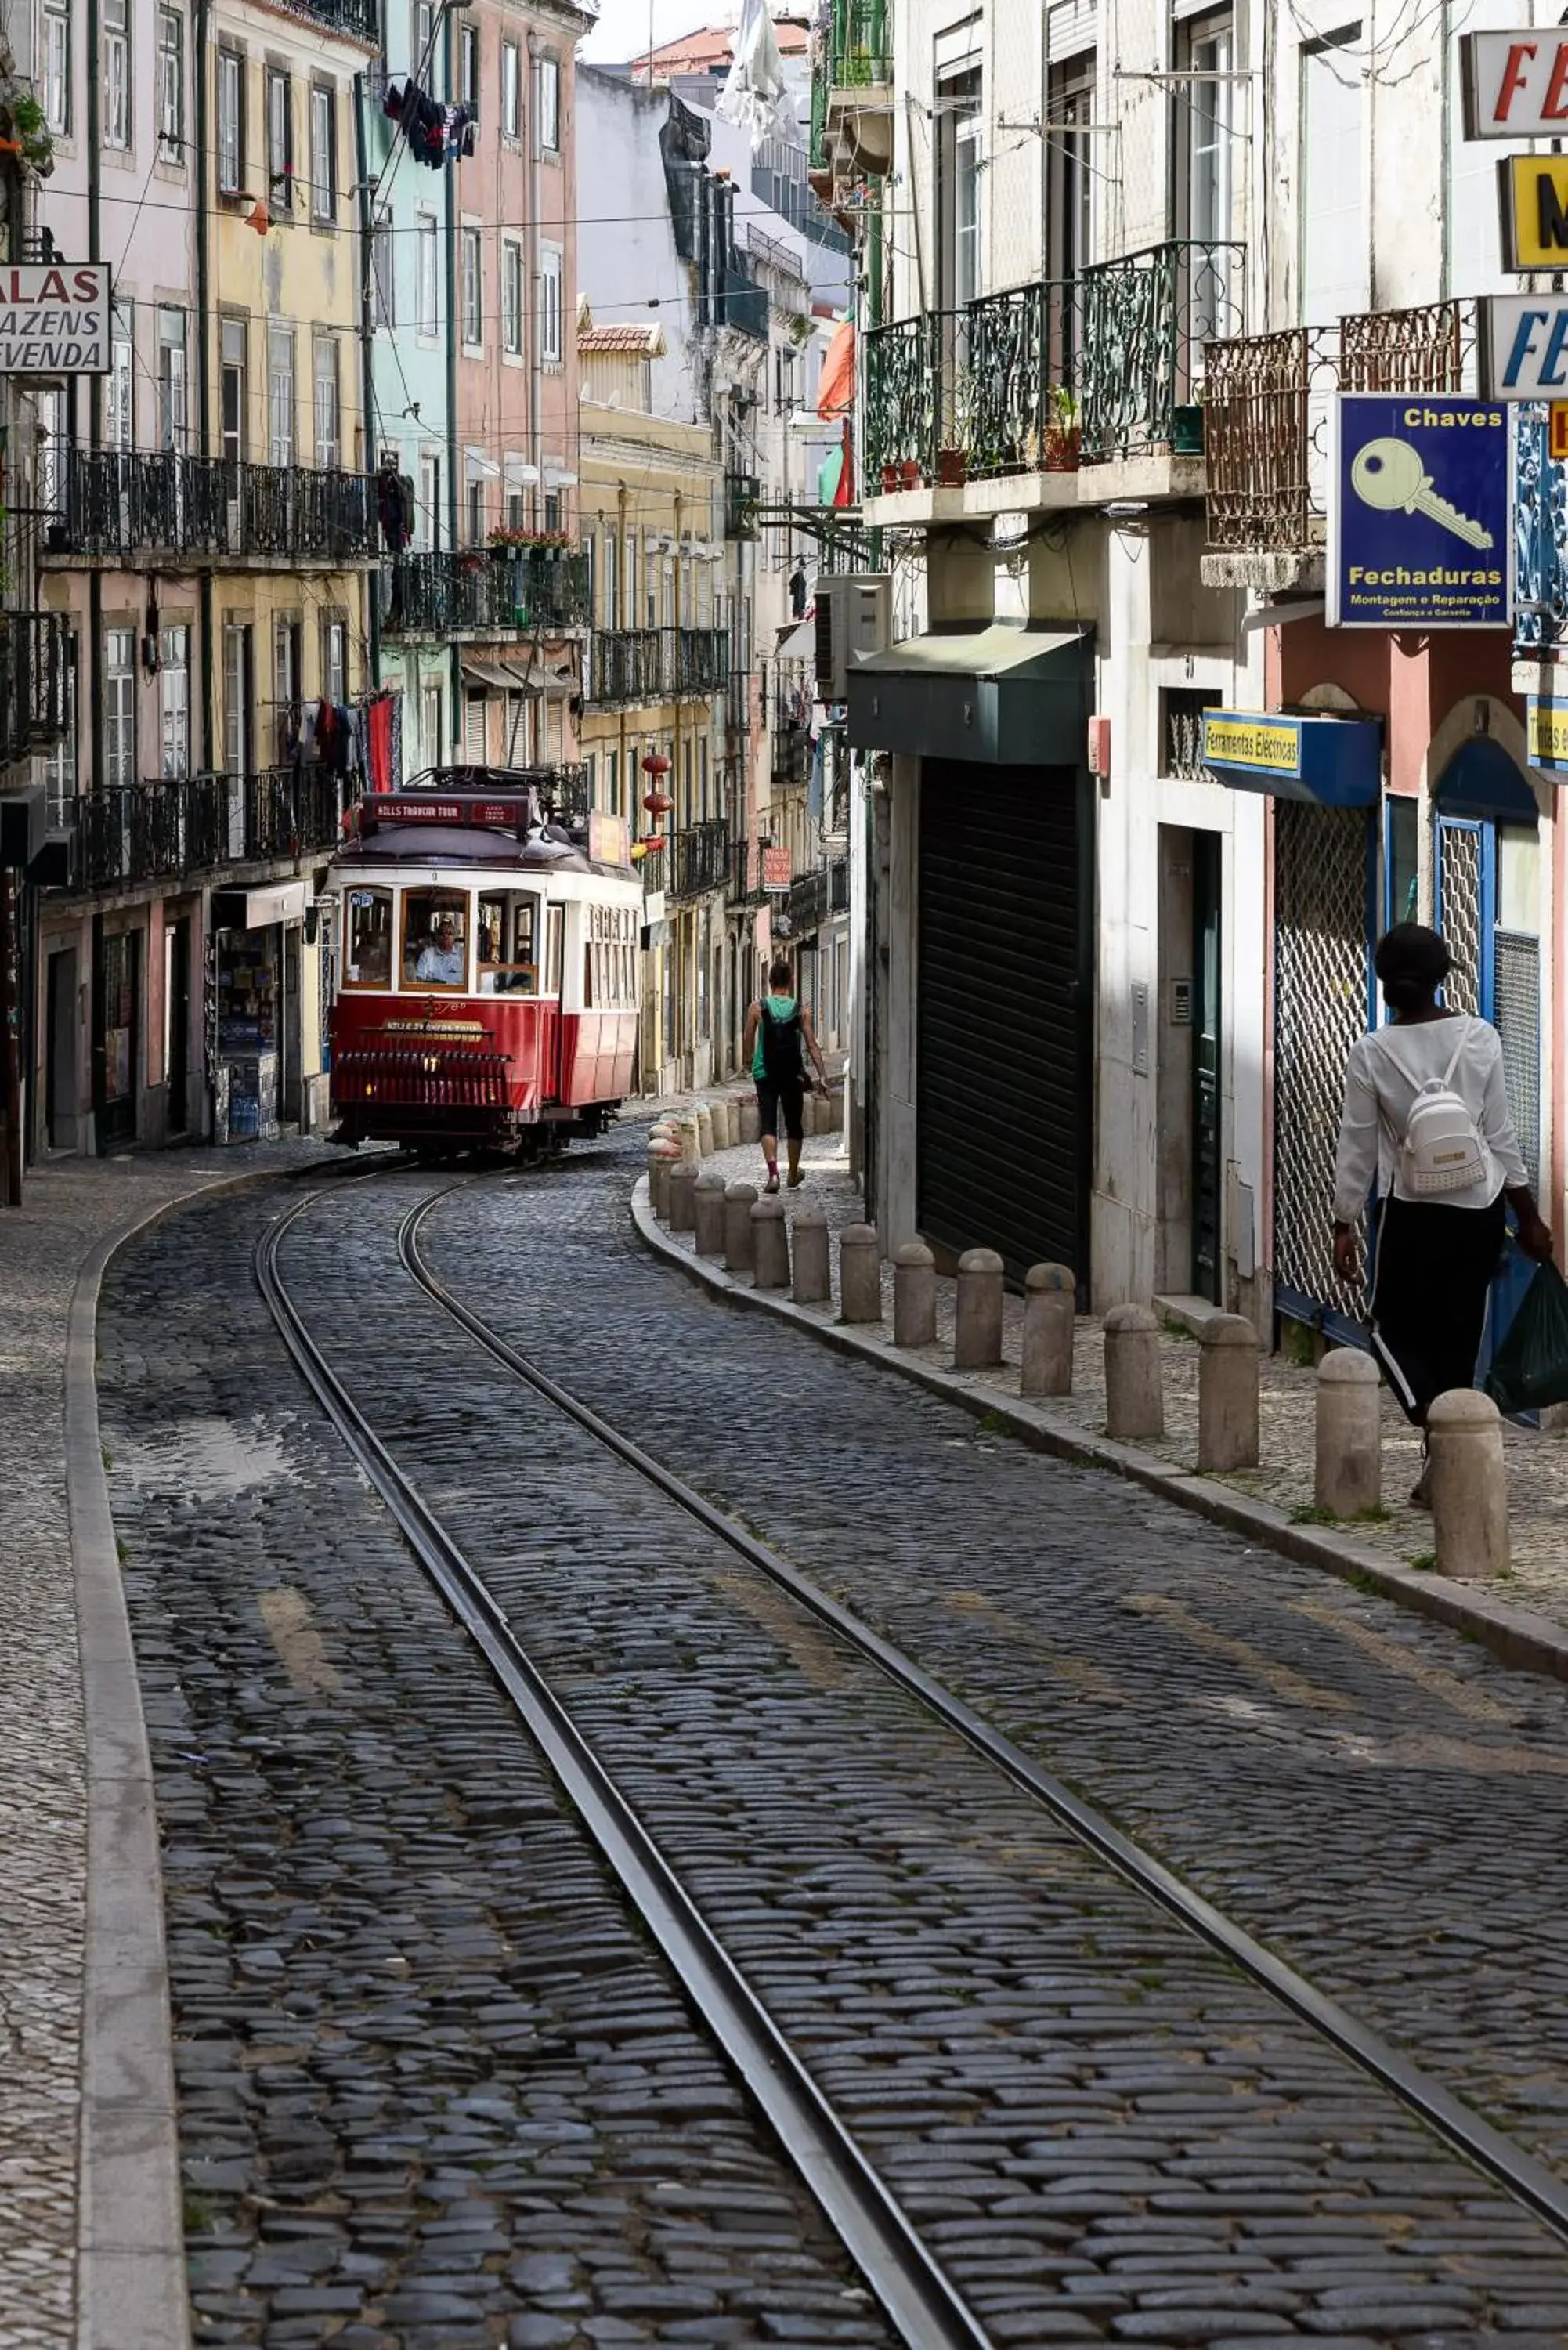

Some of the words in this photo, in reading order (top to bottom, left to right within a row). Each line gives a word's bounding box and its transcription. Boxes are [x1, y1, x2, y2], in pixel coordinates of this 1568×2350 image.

[0, 269, 99, 303] LAS
[0, 342, 100, 367] VENDA
[1501, 309, 1568, 387] FE
[1404, 407, 1502, 427] Chaves
[1349, 566, 1502, 585] Fechaduras
[1350, 594, 1417, 607] Montagem
[1420, 595, 1428, 605] e
[1432, 594, 1500, 607] Reparação
[1206, 725, 1253, 757] Ferramentas
[1255, 730, 1297, 762] Eléctricas
